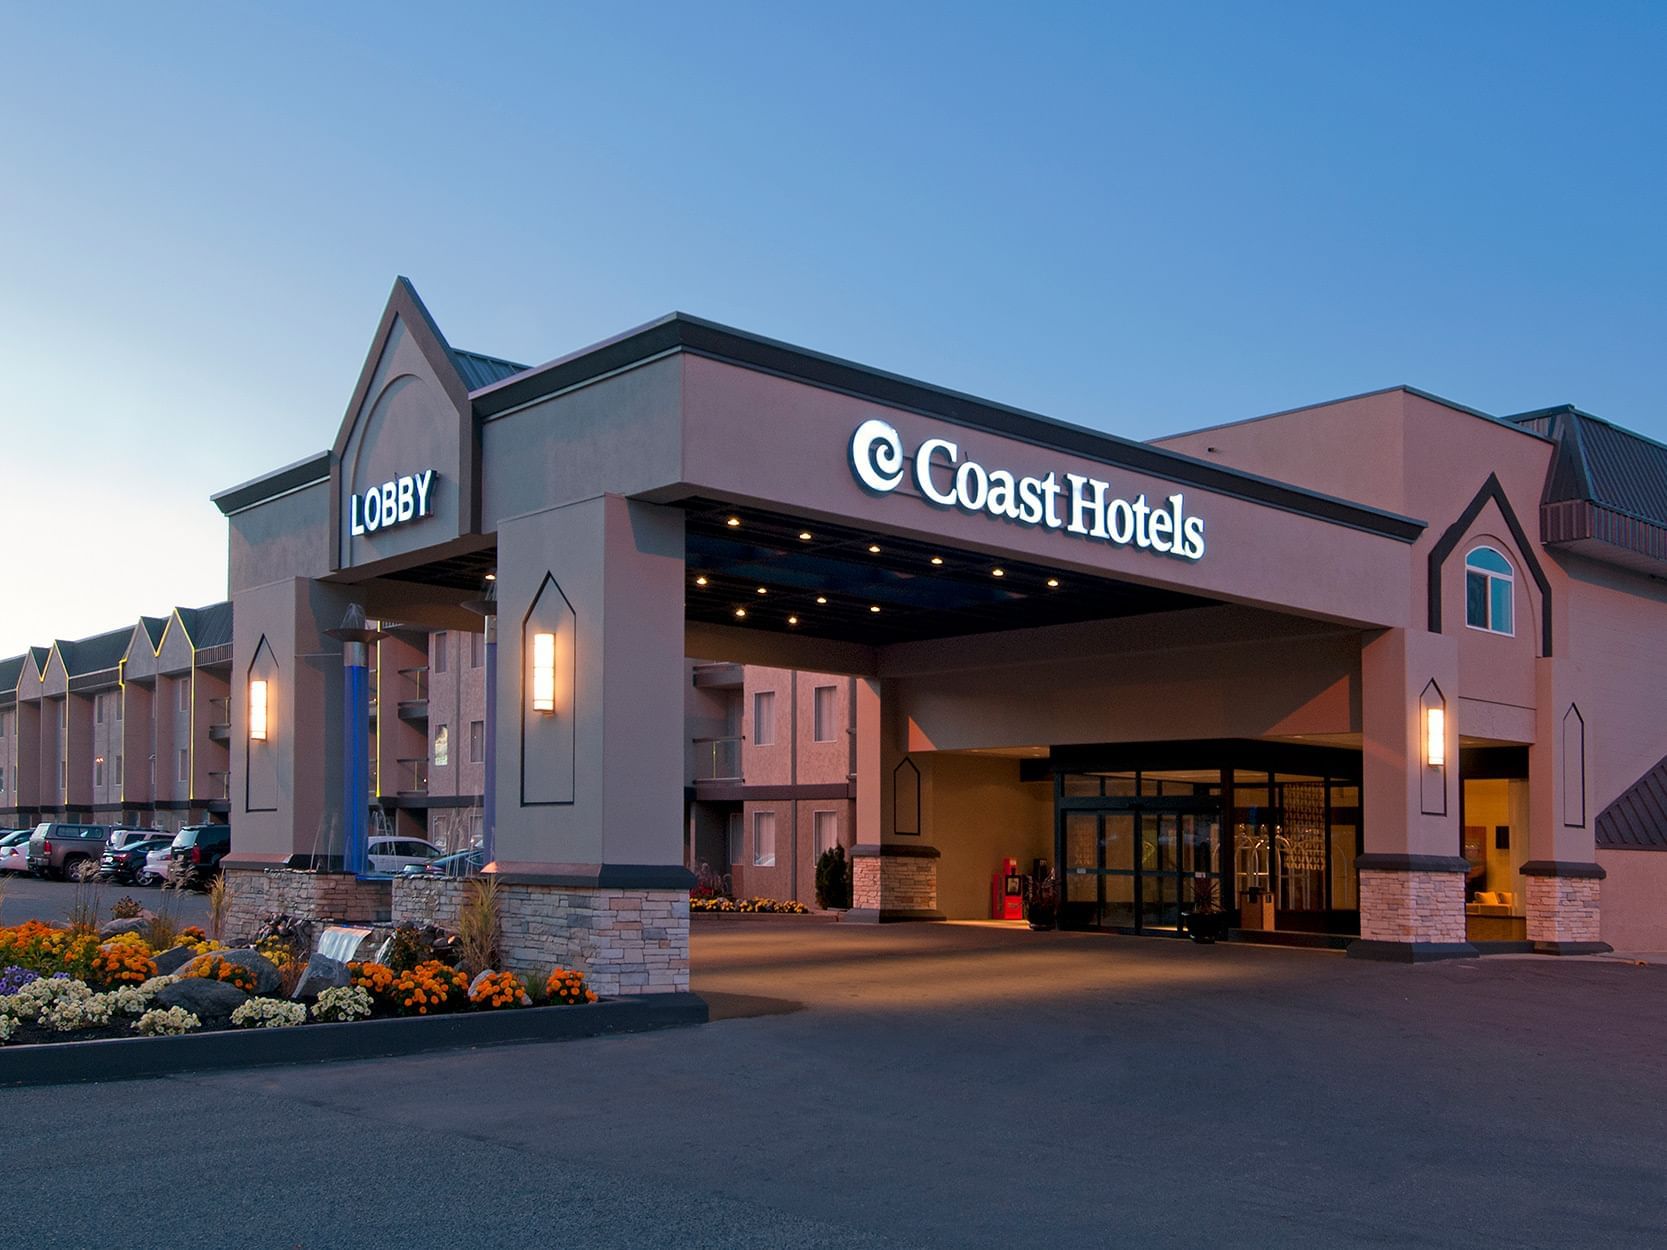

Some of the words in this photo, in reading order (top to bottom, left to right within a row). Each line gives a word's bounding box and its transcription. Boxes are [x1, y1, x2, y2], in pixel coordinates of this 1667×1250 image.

[351, 469, 432, 536] LOBBY
[916, 438, 1062, 528] Coast
[1066, 472, 1205, 559] Hotels
